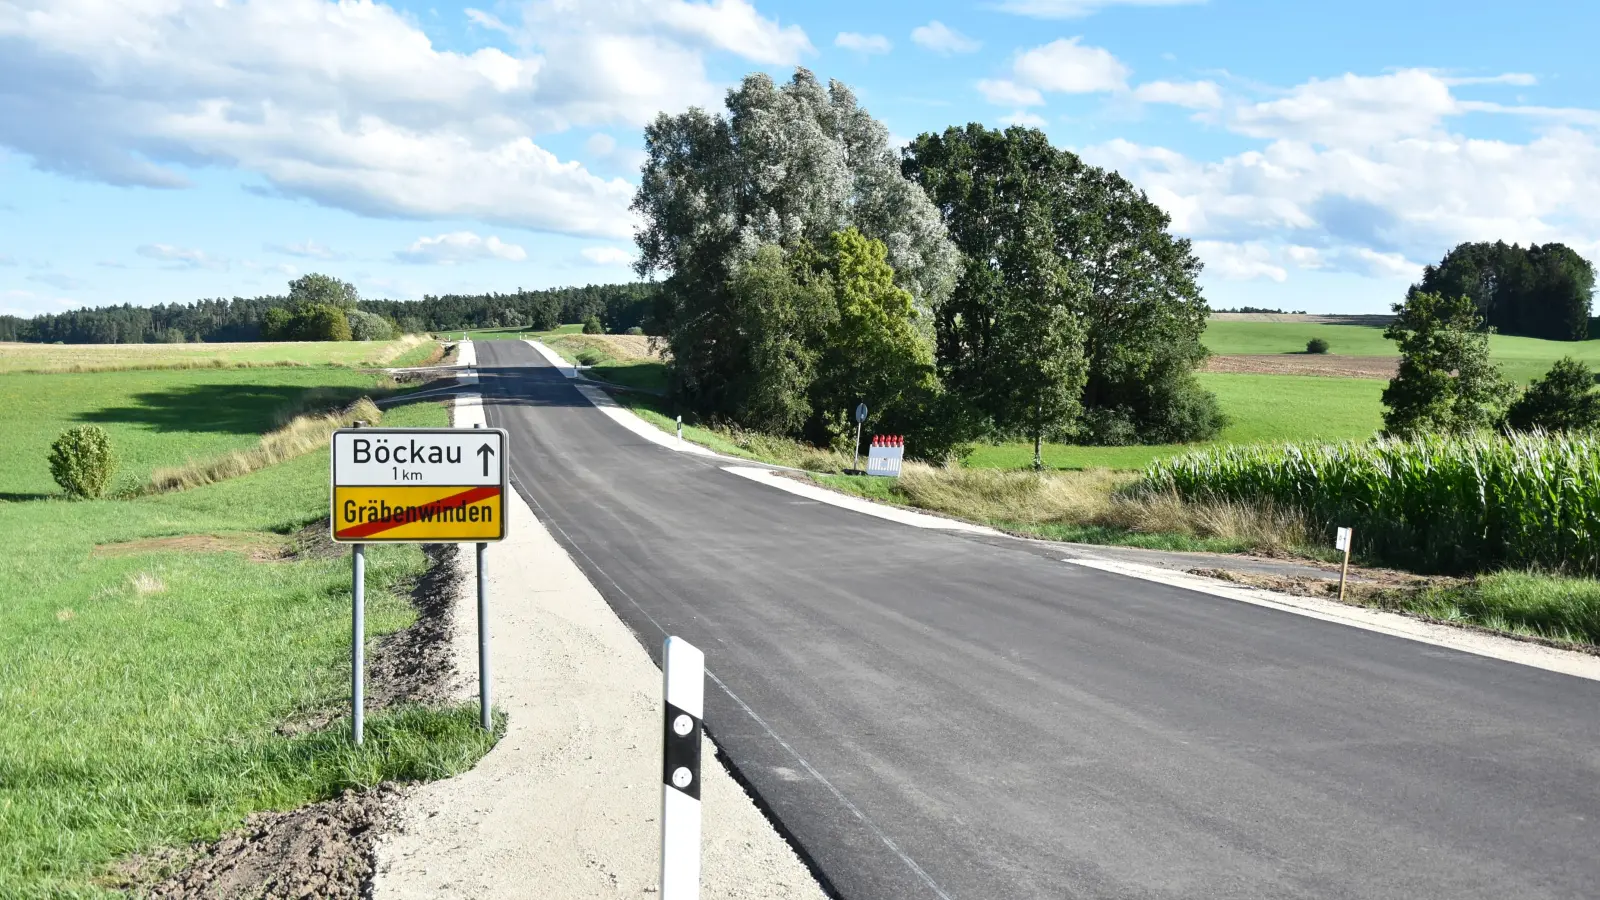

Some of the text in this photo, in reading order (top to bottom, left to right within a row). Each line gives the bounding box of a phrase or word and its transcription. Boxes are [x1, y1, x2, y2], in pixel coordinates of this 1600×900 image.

[353, 439, 462, 464] Böckau
[392, 466, 423, 480] 1 km
[344, 499, 492, 523] Gräbenwinden
